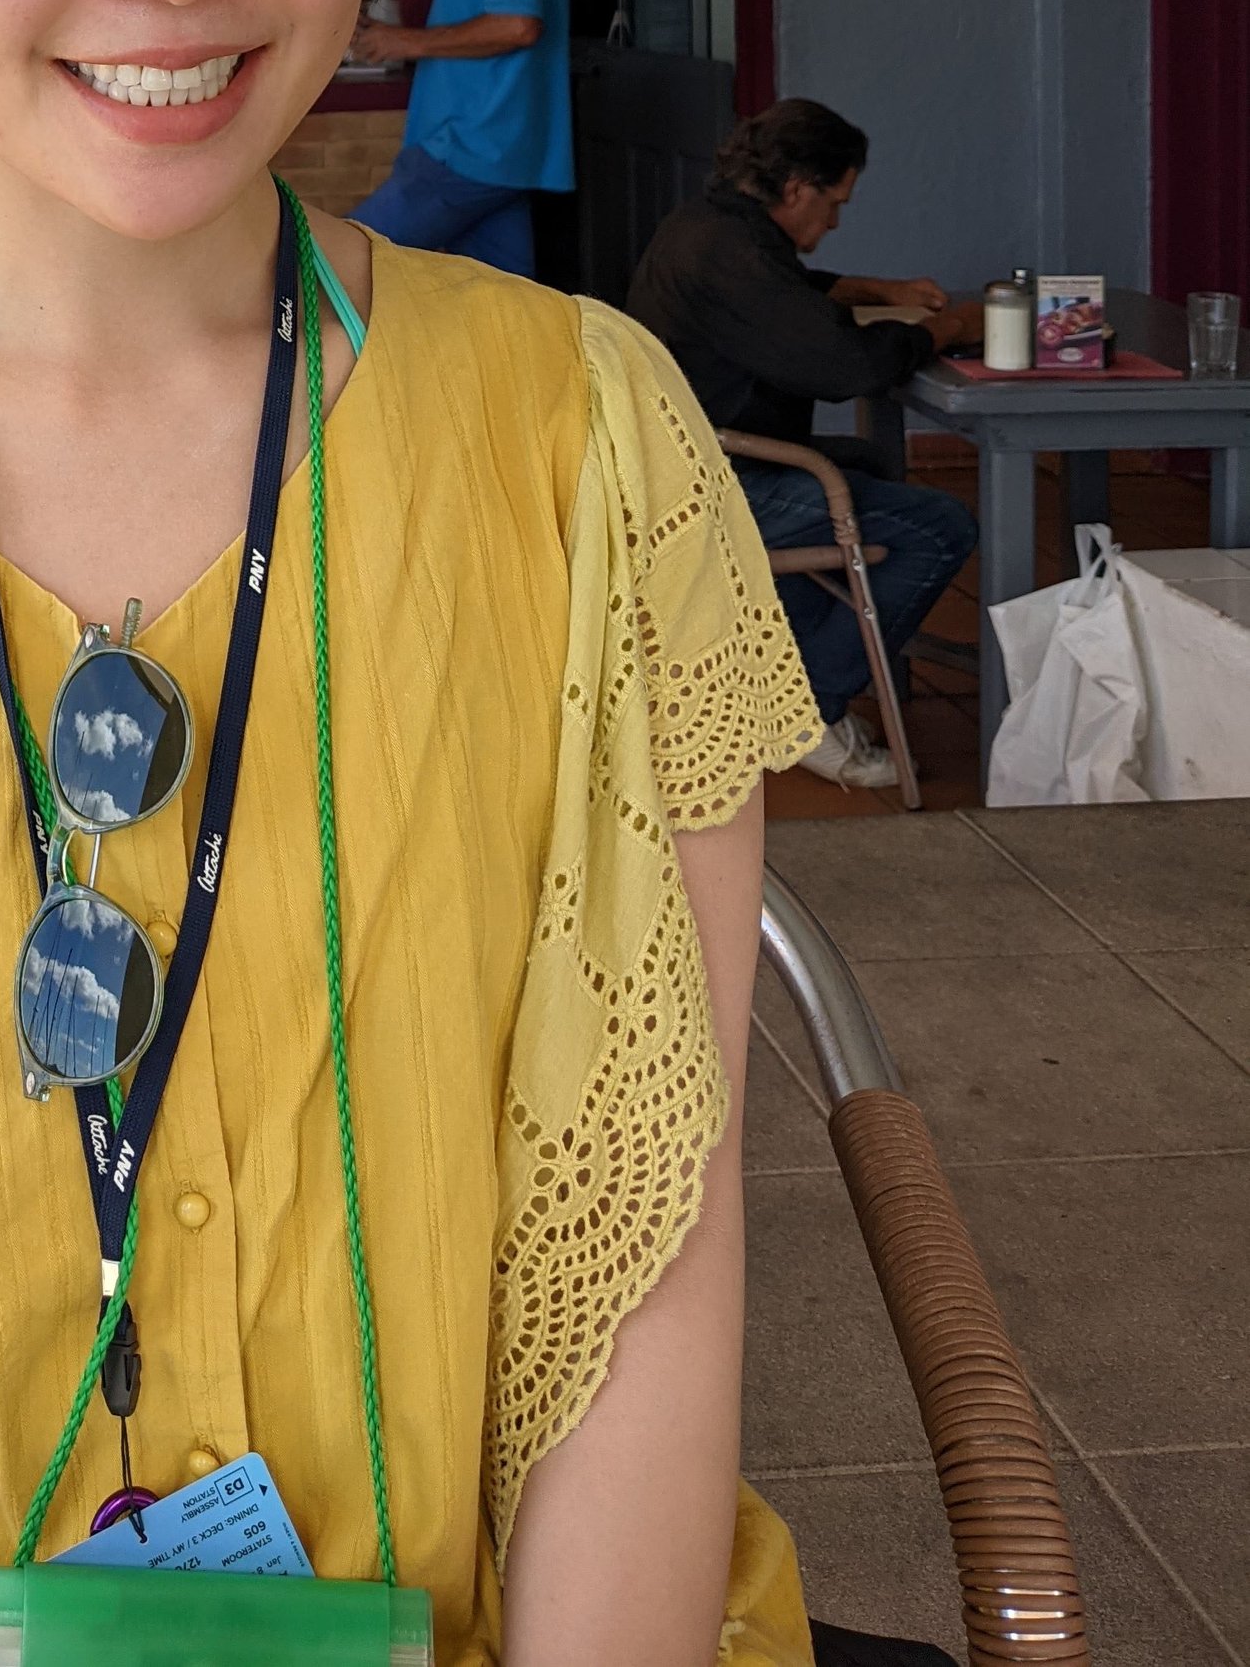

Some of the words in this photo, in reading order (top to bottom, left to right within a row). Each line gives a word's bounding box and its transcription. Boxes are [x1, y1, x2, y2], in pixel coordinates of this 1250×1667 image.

[248, 548, 267, 594] PNY
[31, 809, 49, 857] PNY
[113, 1139, 135, 1192] PNY
[182, 1486, 217, 1509] STATION
[224, 1477, 245, 1495] D3
[181, 1497, 220, 1523] ASSEMBLY
[225, 1503, 260, 1526] DINING:
[199, 1522, 225, 1540] DECK
[243, 1520, 266, 1539] 605
[147, 1551, 171, 1568] TIME
[172, 1542, 185, 1555] MY
[222, 1534, 273, 1567] STATEROOM
[267, 1555, 282, 1568] Jan
